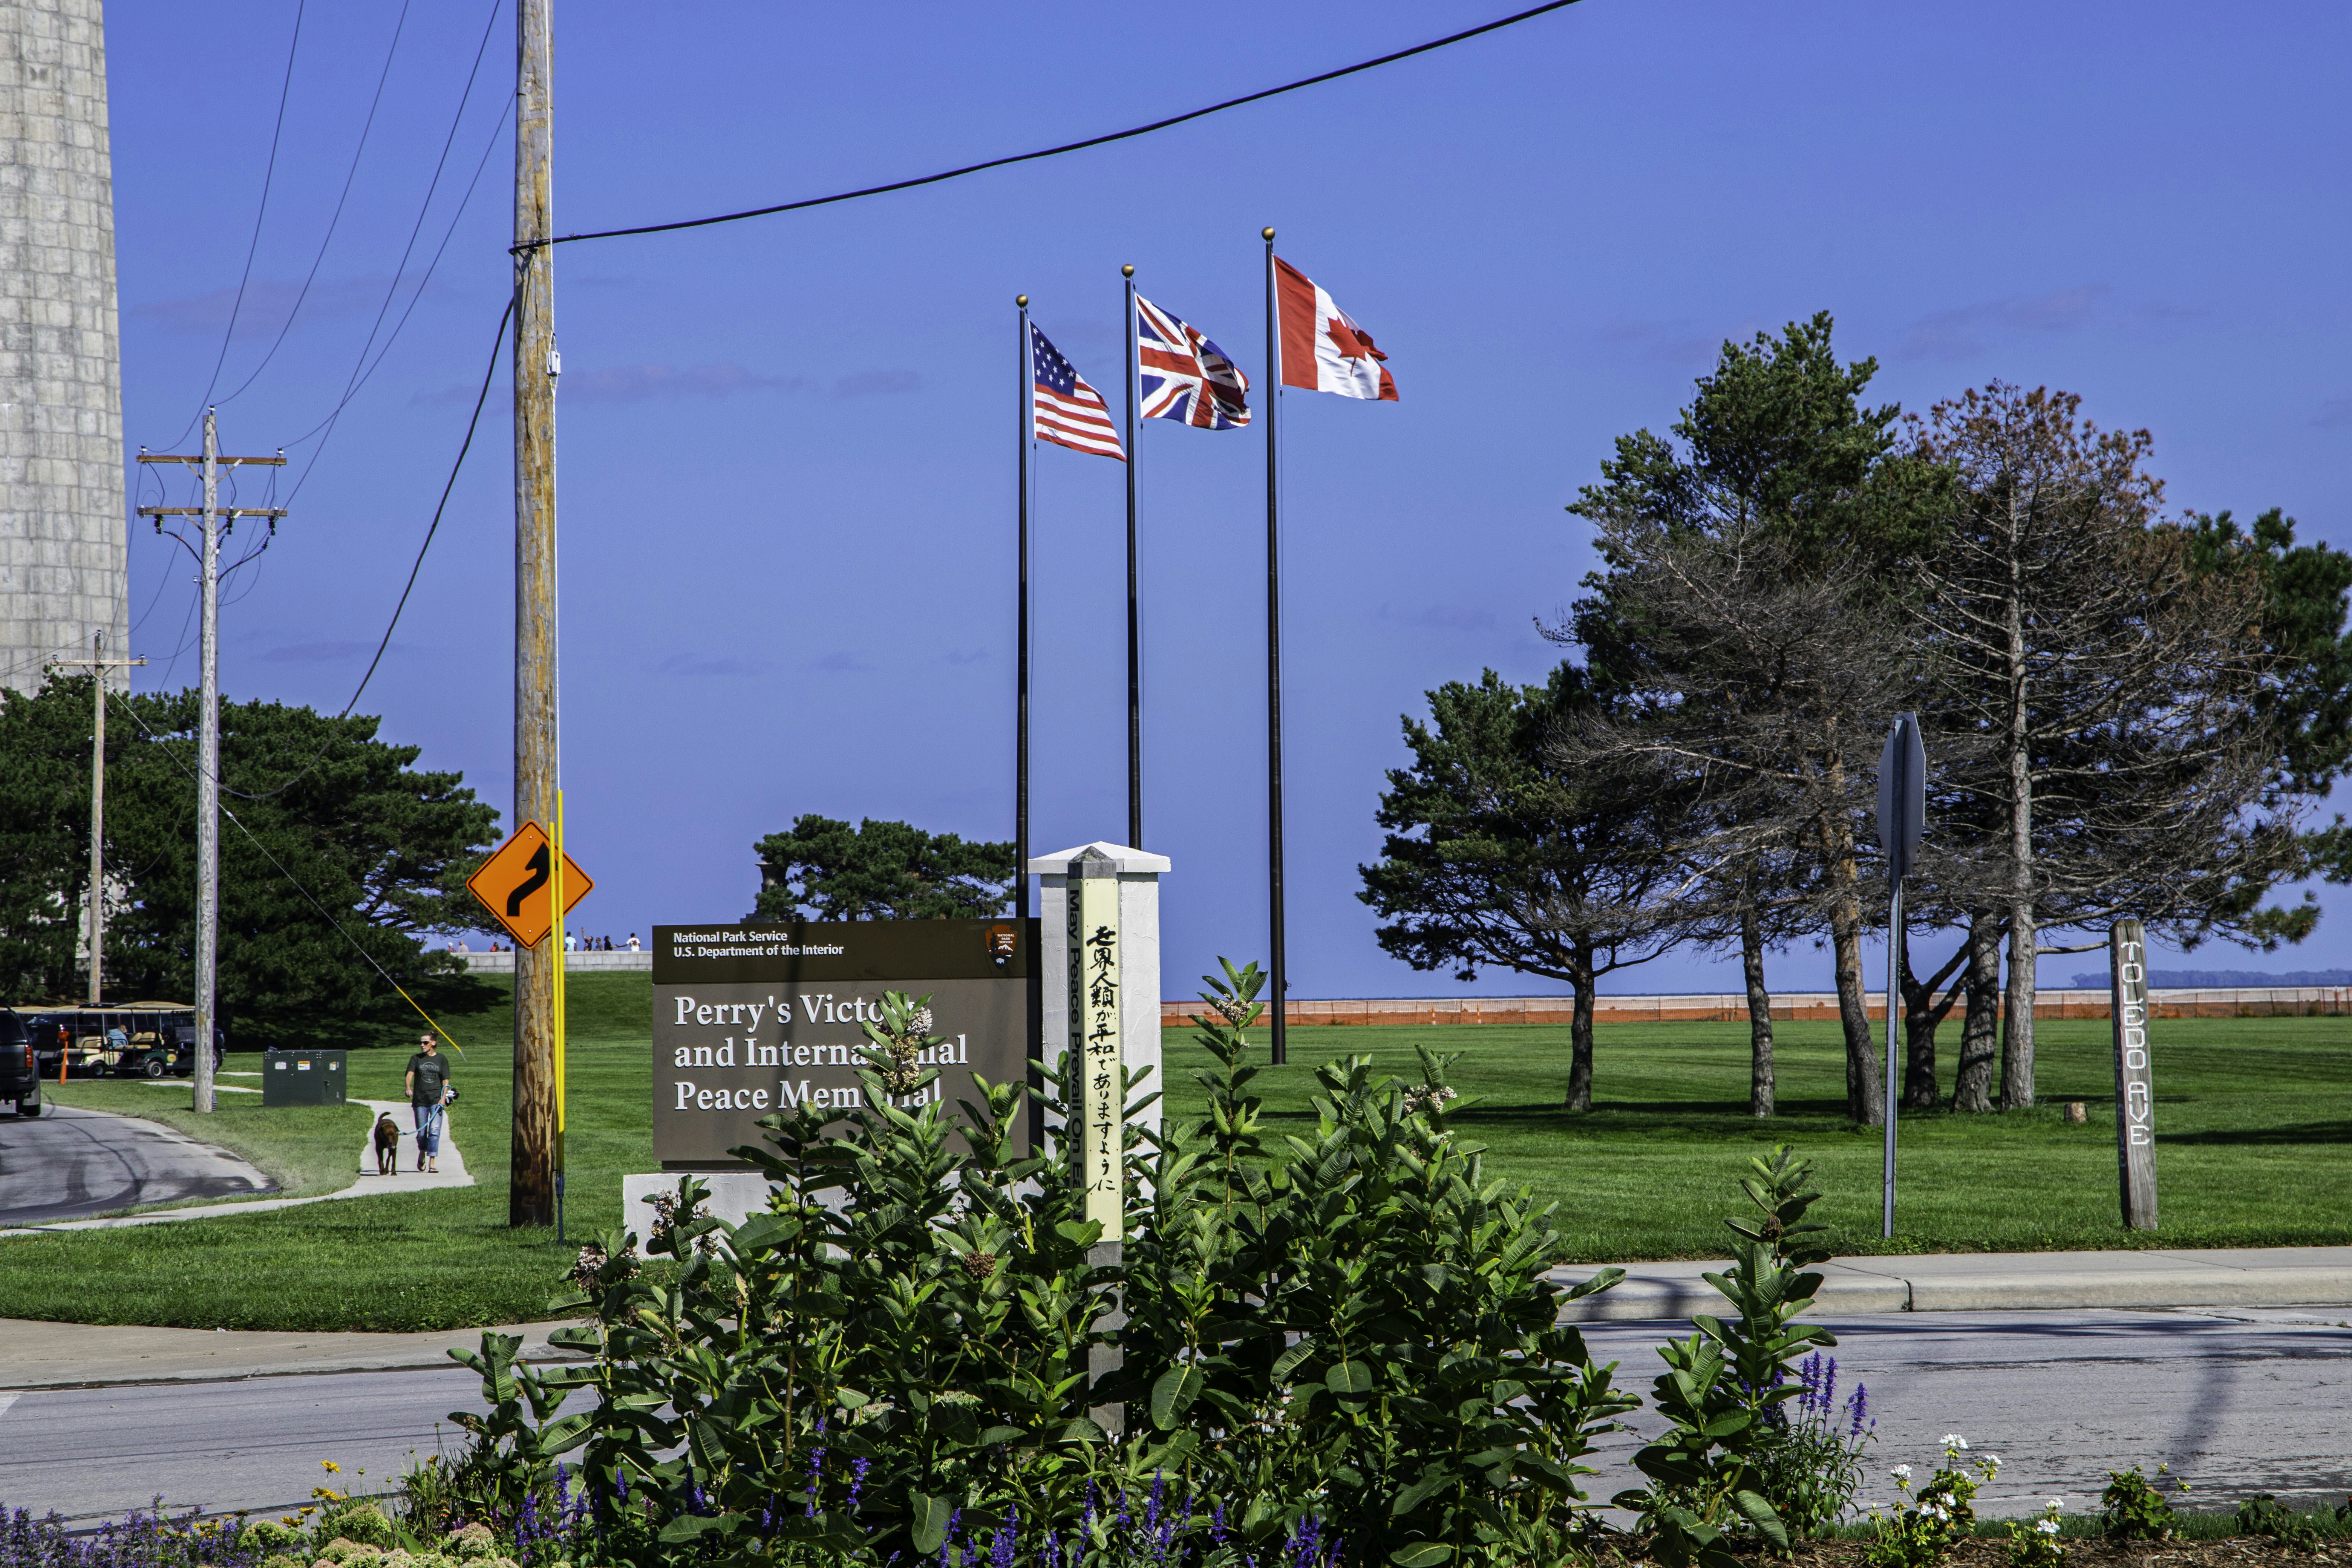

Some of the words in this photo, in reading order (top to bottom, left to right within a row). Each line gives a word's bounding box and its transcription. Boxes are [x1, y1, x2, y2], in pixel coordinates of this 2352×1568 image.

[674, 931, 720, 943] National
[723, 931, 746, 942] Park
[749, 931, 788, 942] Service
[1067, 889, 1080, 940] May
[674, 947, 695, 957] U.S.
[698, 946, 764, 959] Department
[766, 945, 779, 956] of
[781, 945, 799, 956] the
[802, 944, 844, 955] Interior
[674, 995, 791, 1034] Perry's
[799, 994, 915, 1023] Victo
[1070, 948, 1081, 1024] Peace
[2121, 942, 2146, 1070] TOLEDO
[675, 1037, 736, 1068] and
[745, 1034, 968, 1066] Internanal
[1071, 1033, 1082, 1111] Prevail
[1086, 926, 1119, 1191] 世界人類が平和でありますように
[675, 1081, 768, 1110] Peace
[778, 1078, 940, 1109] Memal
[2128, 1081, 2150, 1146] AVE
[1072, 1118, 1083, 1153] On
[2117, 1103, 2127, 1168] AVE
[1073, 1162, 1083, 1223] Eah
